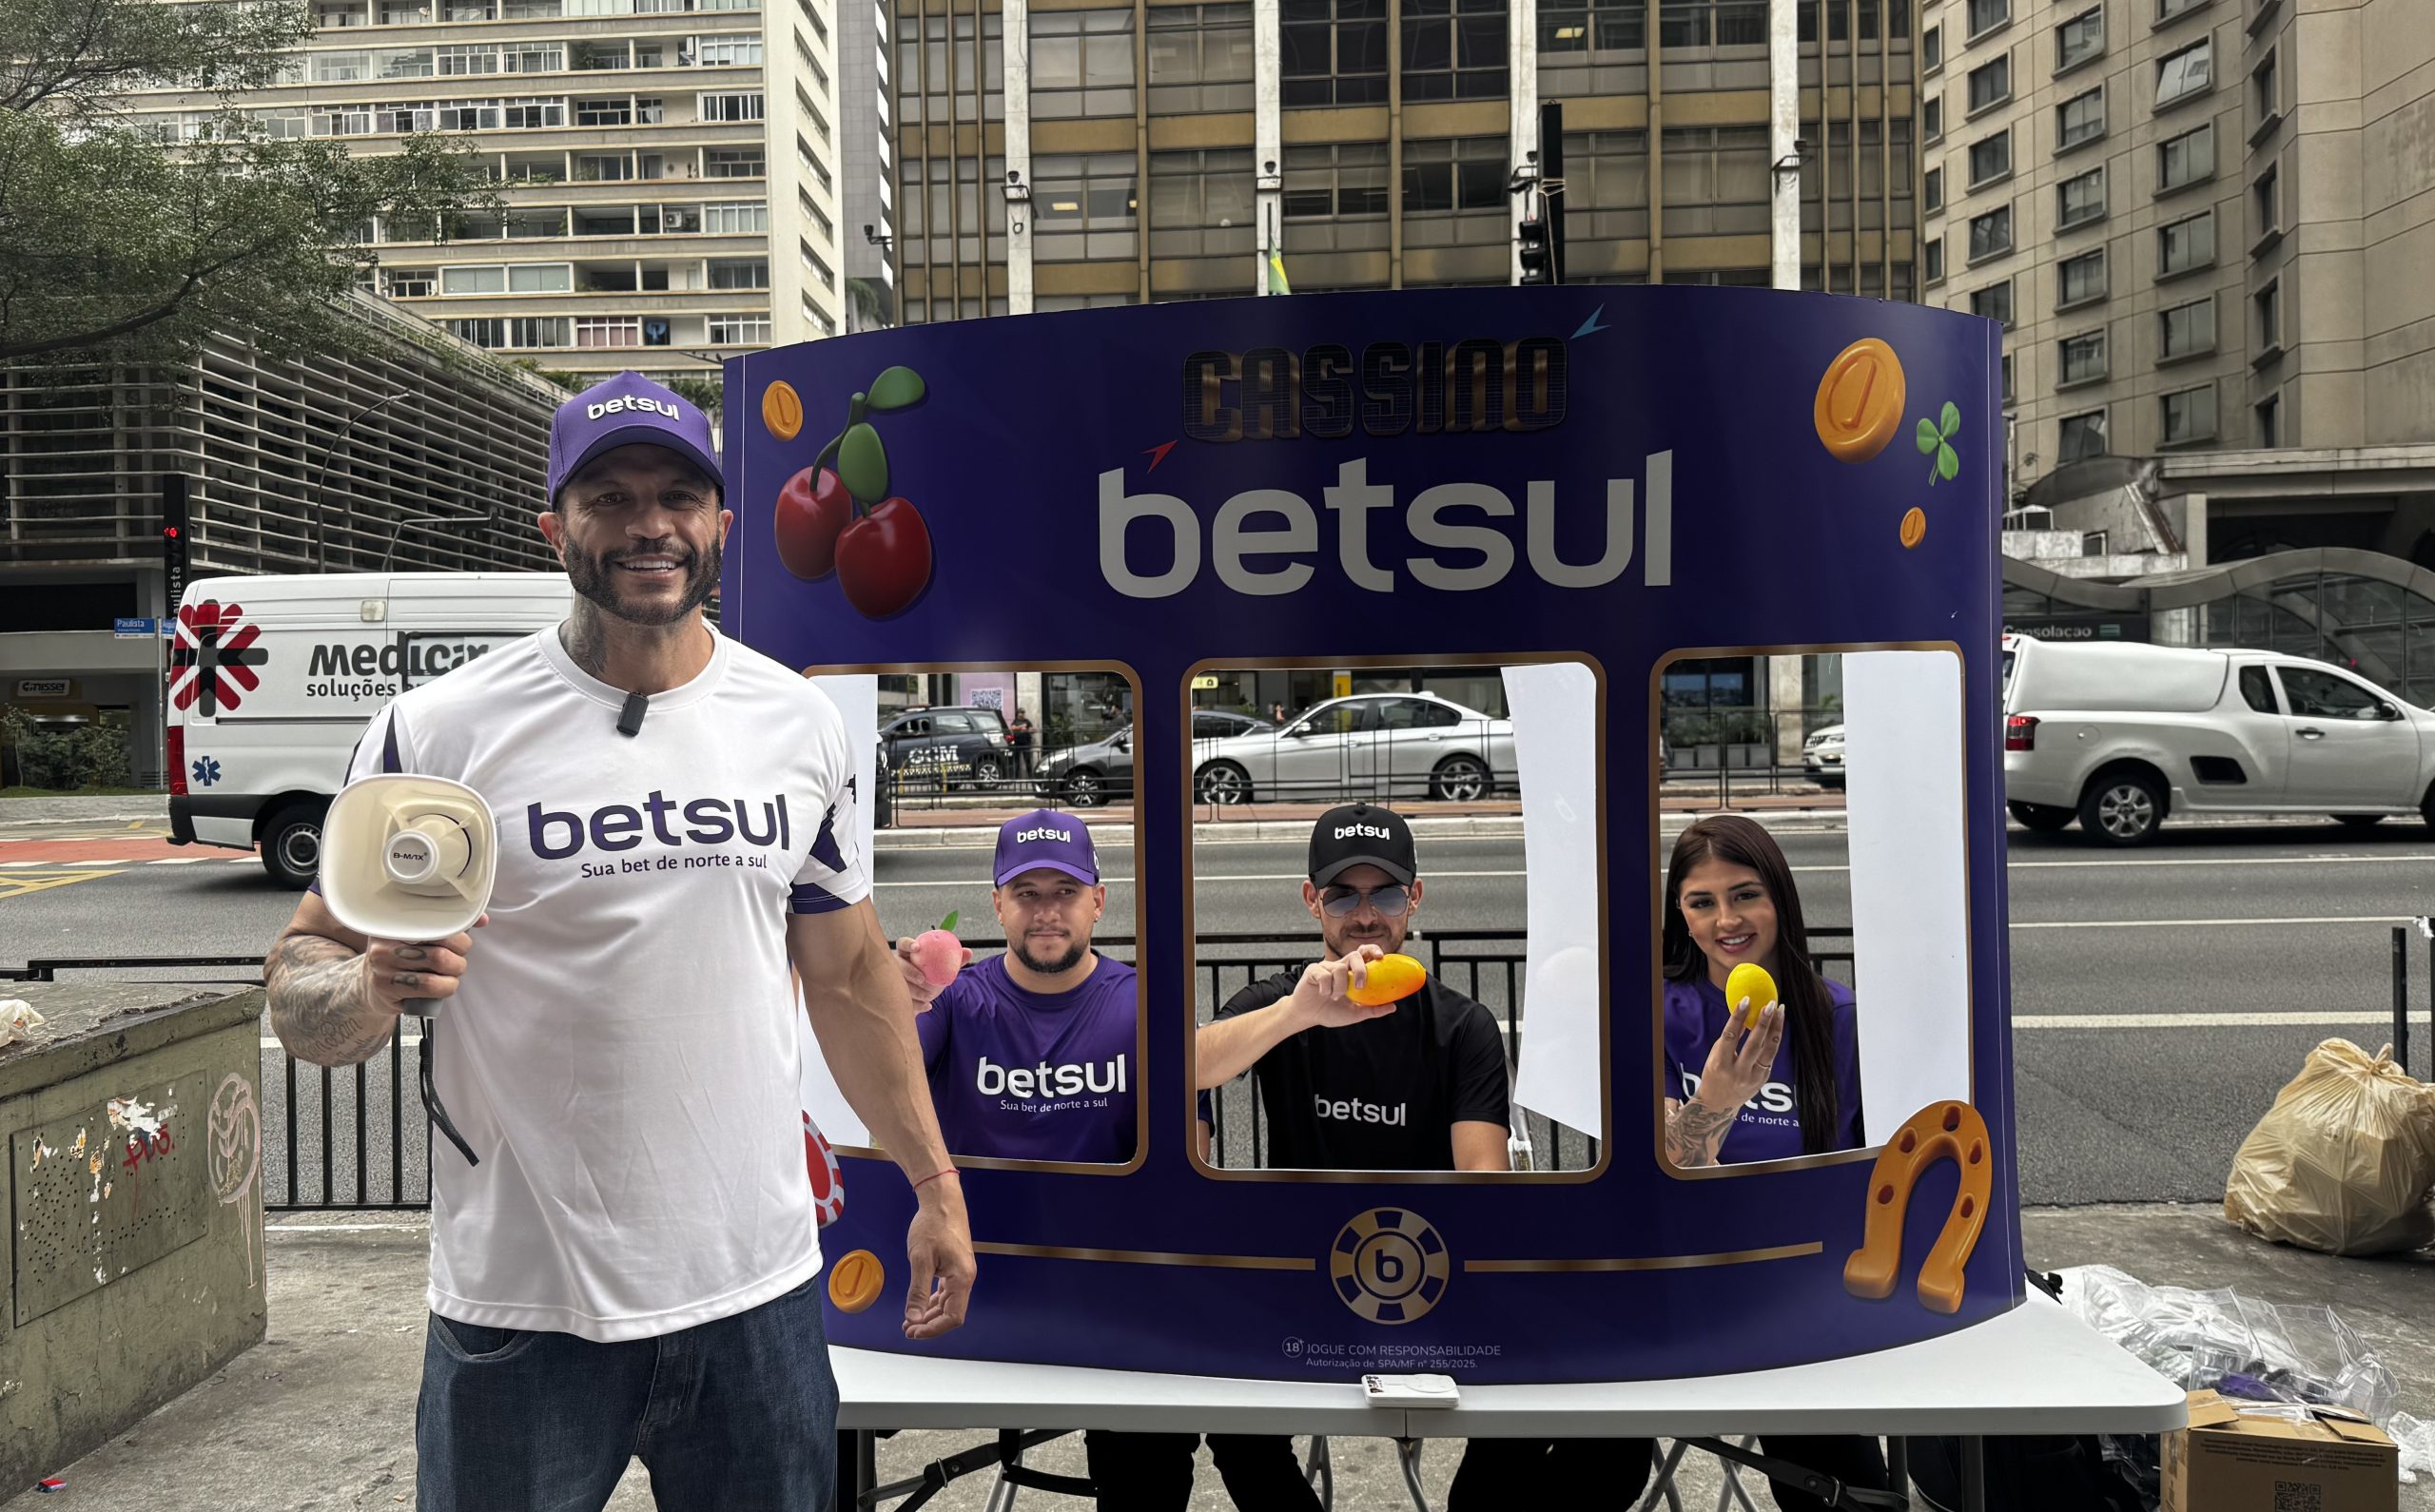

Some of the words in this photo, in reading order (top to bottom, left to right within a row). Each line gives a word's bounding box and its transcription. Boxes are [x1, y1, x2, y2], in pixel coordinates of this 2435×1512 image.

[1182, 336, 1568, 442] CASSINO
[587, 395, 680, 421] betsul
[1099, 449, 1673, 599] betsul
[306, 678, 397, 702] soluções
[527, 790, 790, 861] betsul
[1017, 826, 1071, 843] betsul
[1334, 823, 1391, 841] betsul
[581, 863, 615, 878] Sua
[621, 858, 651, 874] bet
[656, 855, 678, 870] de
[684, 853, 730, 868] norte
[735, 856, 744, 866] a
[748, 854, 768, 869] sul
[977, 1053, 1127, 1098] betsul
[1000, 1099, 1019, 1111] Sua
[1021, 1103, 1037, 1113] bet
[1040, 1102, 1052, 1113] de
[1054, 1099, 1081, 1111] norte
[1092, 1097, 1108, 1108] sul
[1314, 1094, 1406, 1127] betsul
[1741, 1113, 1755, 1123] de
[1758, 1115, 1790, 1127] norte
[1375, 1248, 1404, 1283] b
[1306, 1344, 1345, 1355] JOGUE
[1348, 1345, 1376, 1355] COM
[1379, 1345, 1502, 1356] RESPONSABILIDADE
[1306, 1357, 1361, 1368] Autorização
[1362, 1358, 1375, 1367] de
[1378, 1359, 1415, 1368] SPA/MF
